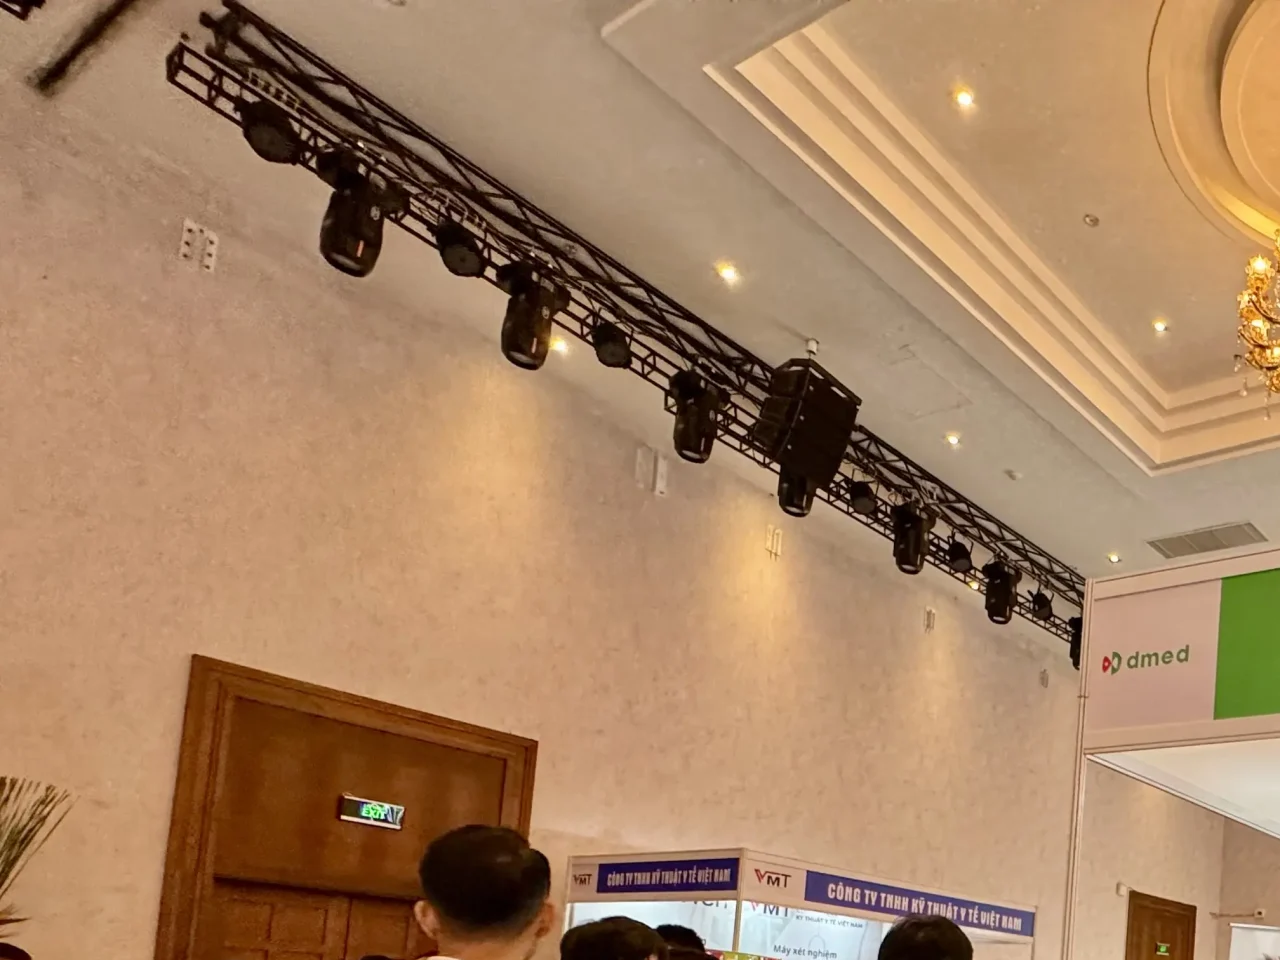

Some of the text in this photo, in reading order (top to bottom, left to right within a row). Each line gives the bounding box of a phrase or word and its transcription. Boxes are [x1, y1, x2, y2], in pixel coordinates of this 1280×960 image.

[1126, 644, 1190, 669] dmed
[573, 873, 592, 886] VMT
[606, 871, 624, 887] CÔNG
[625, 872, 634, 886] TY
[634, 871, 651, 885] TNHH
[682, 870, 688, 884] Y
[688, 865, 698, 884] TẾ
[698, 867, 713, 885] VIỆT
[713, 868, 731, 883] NAM
[754, 868, 792, 888] VMT
[827, 882, 1022, 931] CÔNG TY TNHH KỸ THUẬT Y TẾ VIỆT NAM
[773, 944, 838, 960] Máy xét nghiệm
